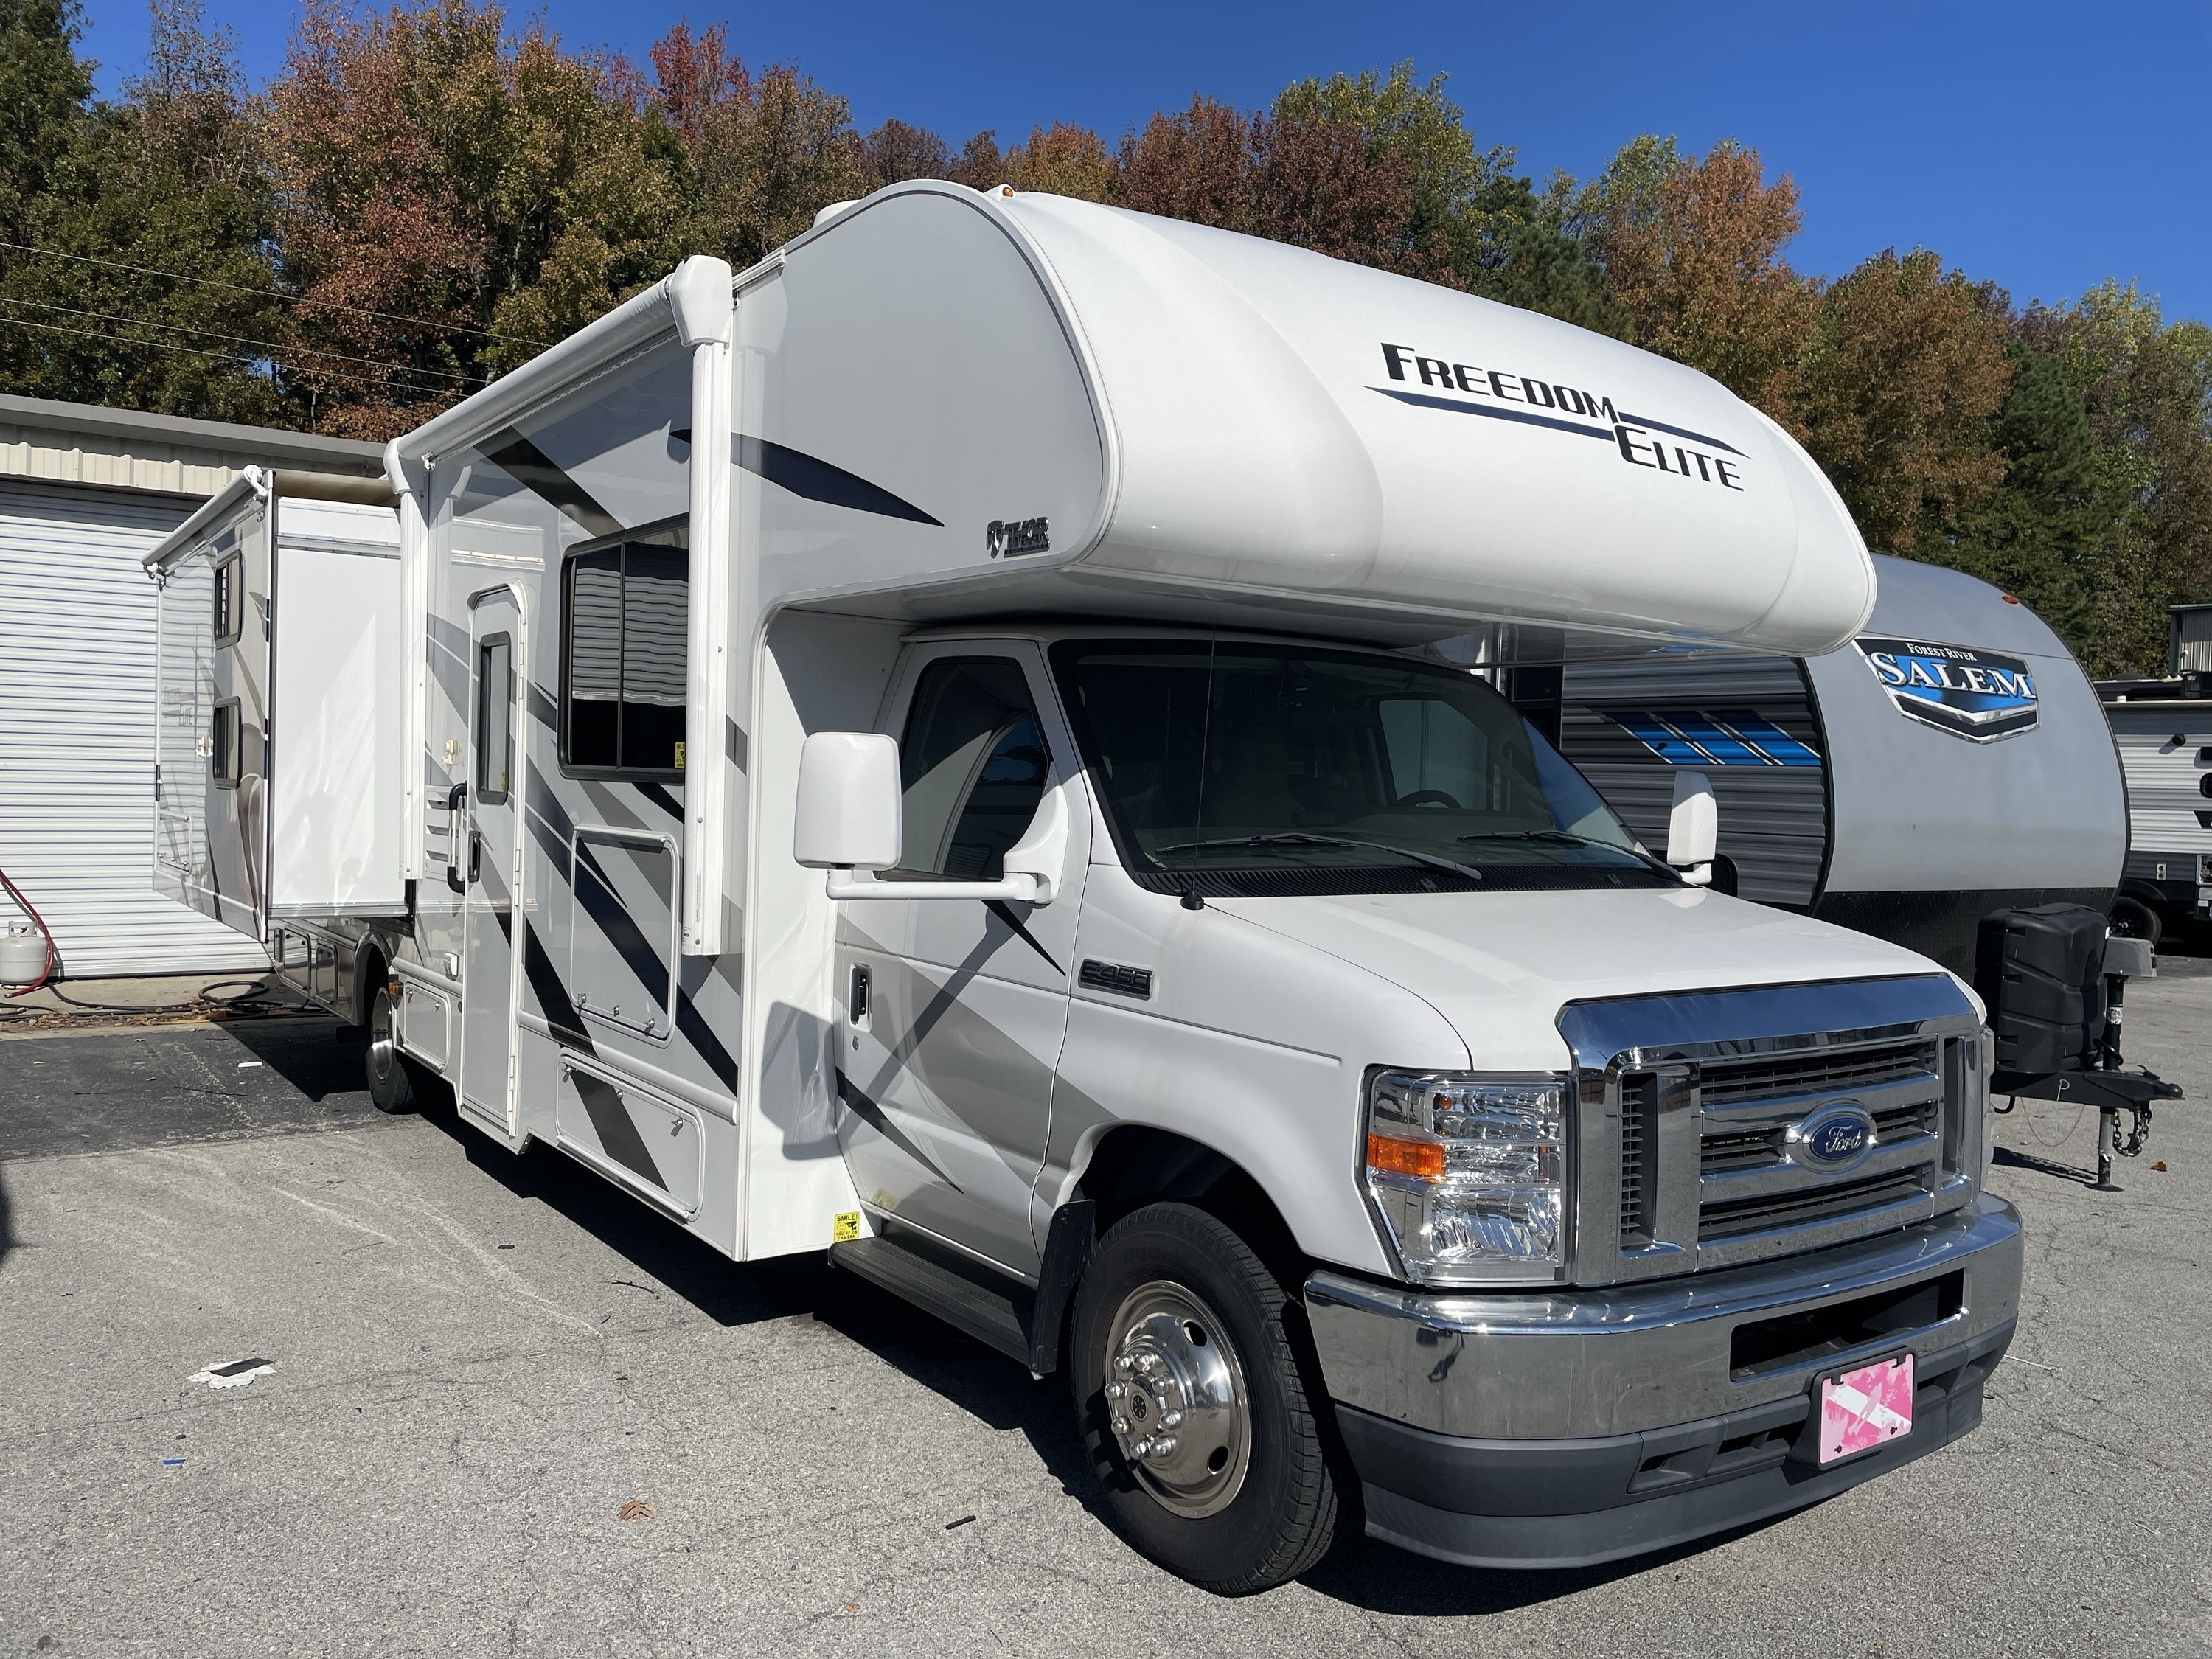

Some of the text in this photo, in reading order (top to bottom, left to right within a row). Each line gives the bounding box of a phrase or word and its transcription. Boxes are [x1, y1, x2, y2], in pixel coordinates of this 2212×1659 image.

[1381, 342, 1618, 423] FREEDOM
[1615, 424, 1745, 491] ELITE
[1004, 517, 1049, 549] THOR
[1906, 643, 1978, 662] FOREST RIVER
[1871, 652, 2037, 699] SALEM
[1825, 1124, 1862, 1153] Ford
[837, 1214, 858, 1222] SMILE!
